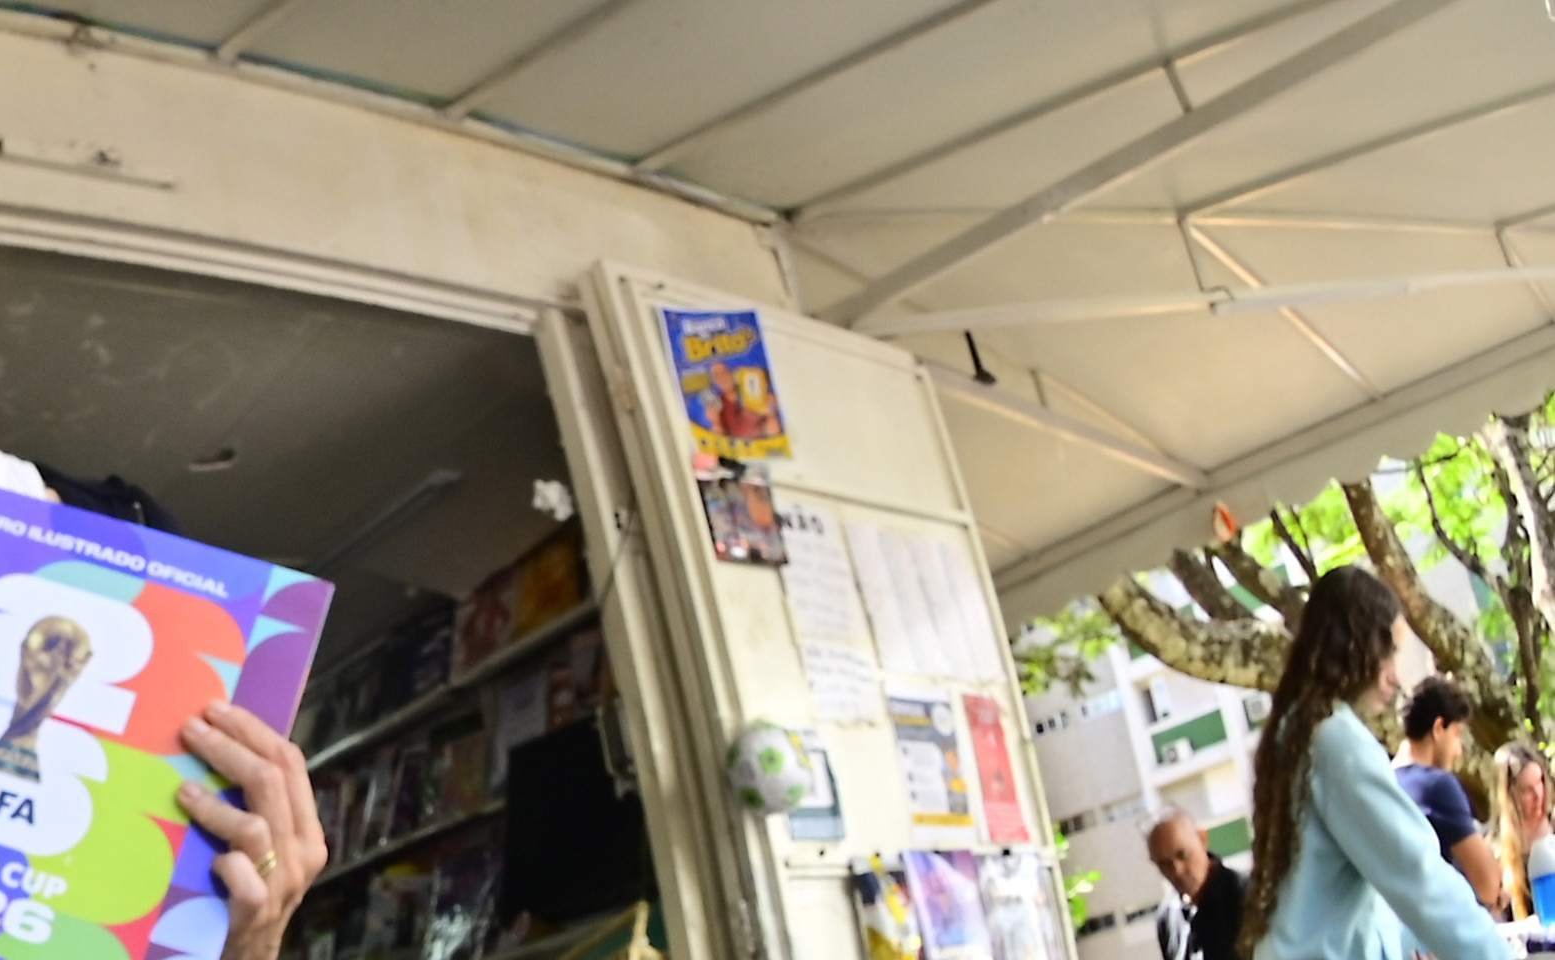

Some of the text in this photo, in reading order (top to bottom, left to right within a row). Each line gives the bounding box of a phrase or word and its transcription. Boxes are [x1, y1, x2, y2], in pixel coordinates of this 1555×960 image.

[28, 525, 147, 572] ILUSTRADO
[147, 560, 229, 598] OFICIAL
[0, 861, 68, 900] CUP
